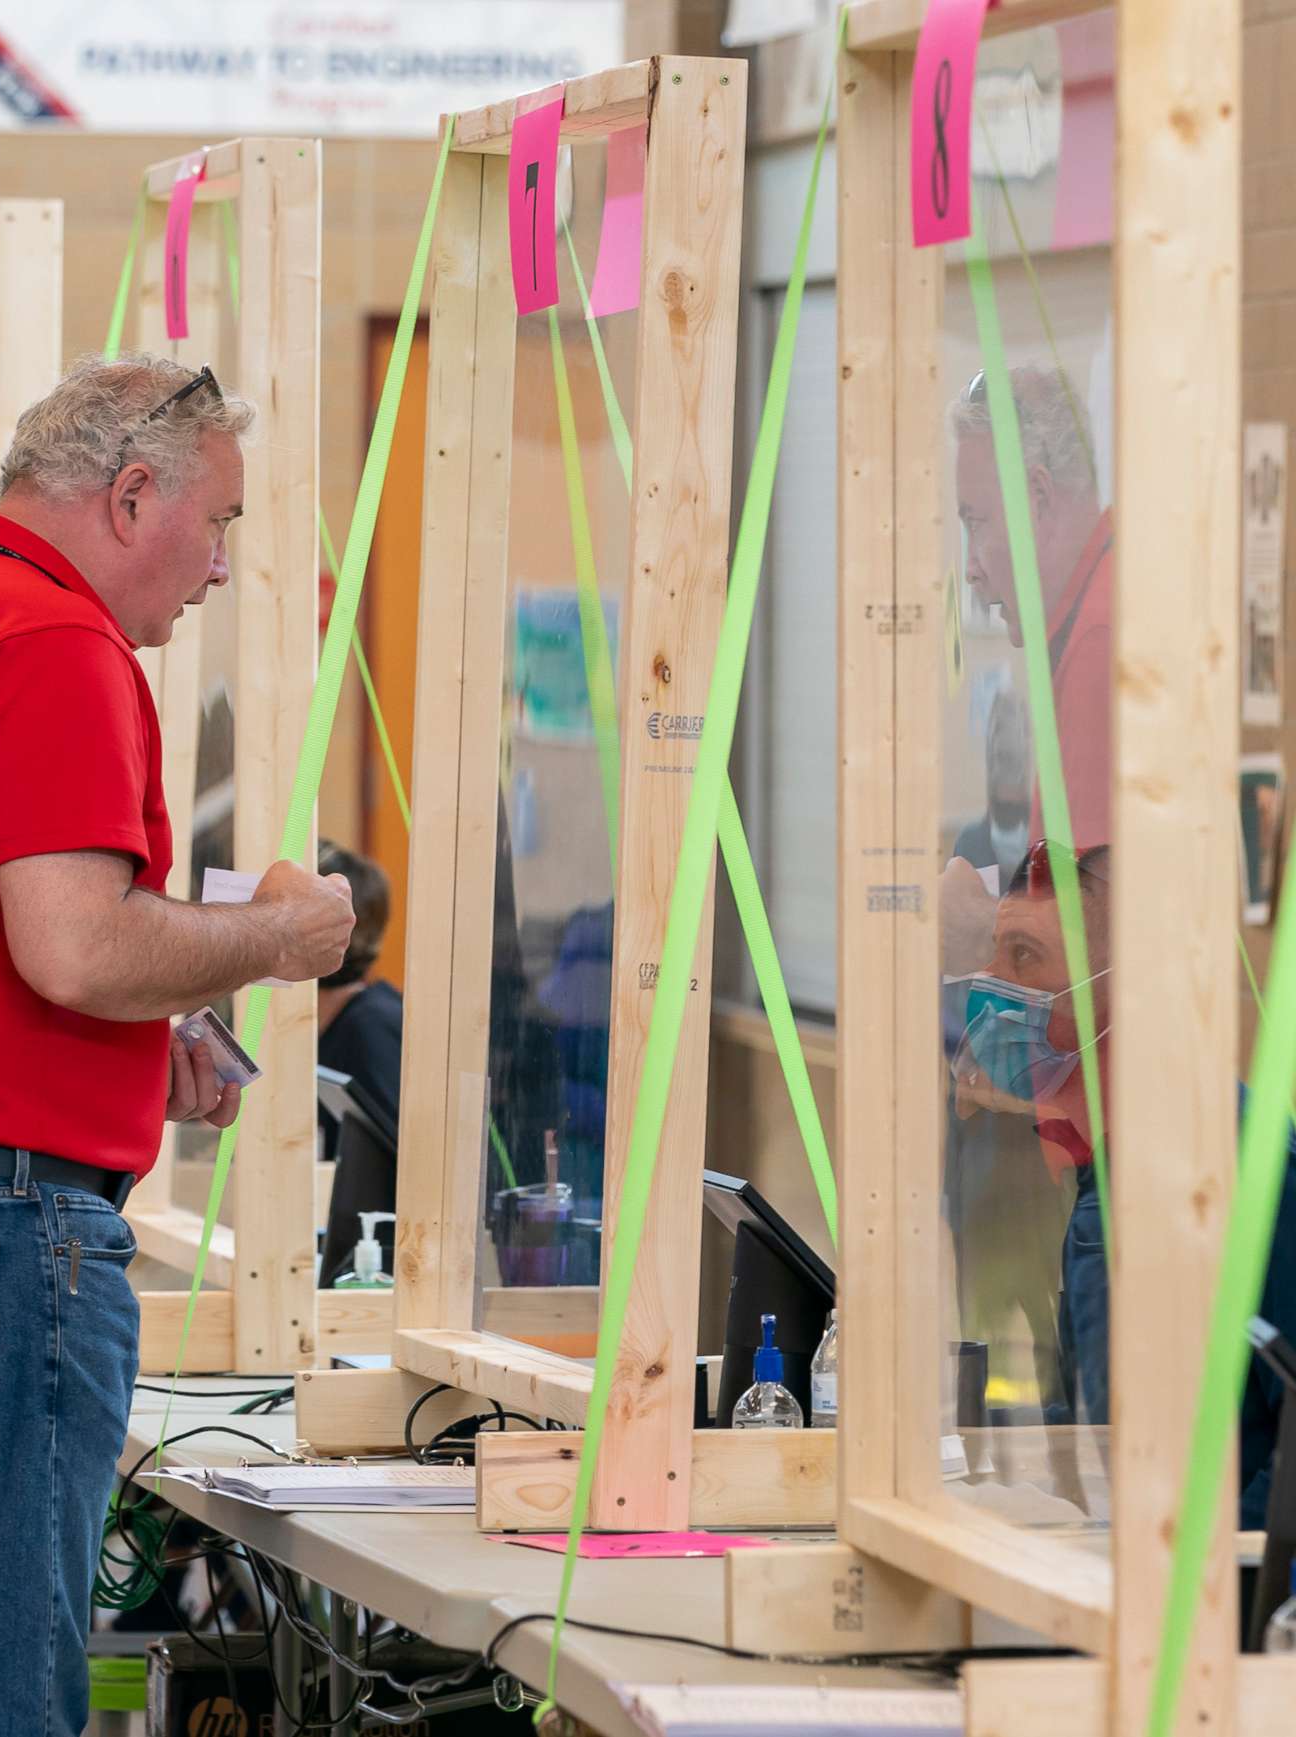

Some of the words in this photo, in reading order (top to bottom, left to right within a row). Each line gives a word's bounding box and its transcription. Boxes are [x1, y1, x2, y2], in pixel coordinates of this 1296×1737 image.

[79, 41, 255, 78] PATHWAY
[268, 43, 317, 78] TO
[326, 44, 584, 82] ENGINEERING
[930, 58, 952, 220] 8
[690, 978, 698, 991] 2
